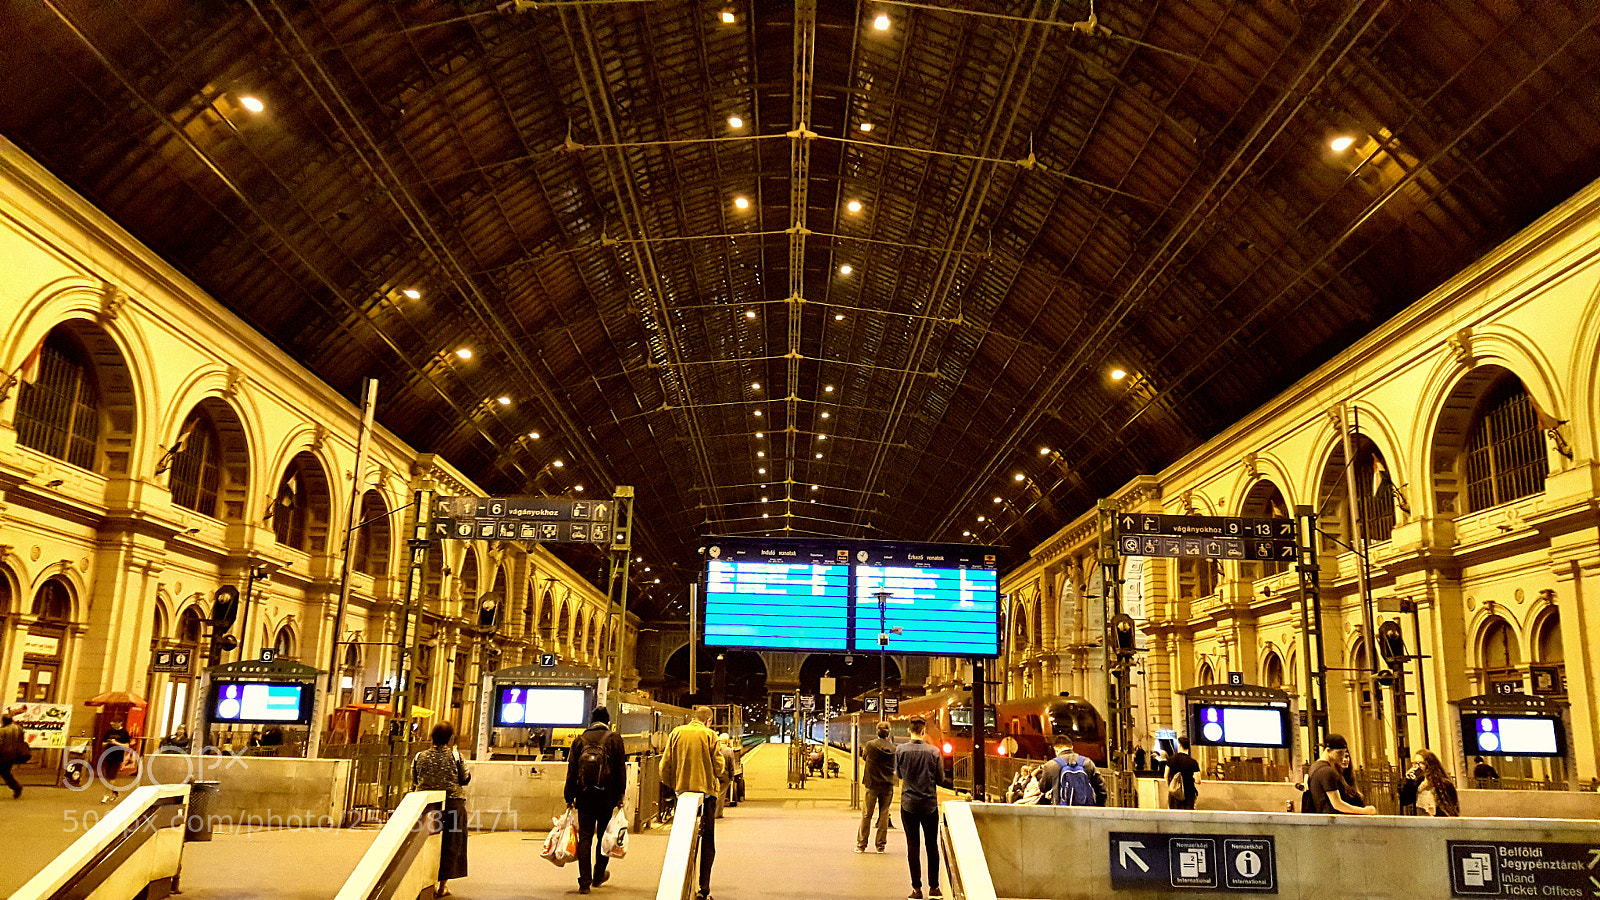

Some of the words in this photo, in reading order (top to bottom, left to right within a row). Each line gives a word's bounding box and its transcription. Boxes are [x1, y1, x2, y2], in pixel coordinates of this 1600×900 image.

[492, 503, 502, 515] 6
[1173, 525, 1222, 534] vágányokhoz
[1229, 523, 1239, 534] 9
[1255, 524, 1271, 535] 13
[262, 651, 271, 660] 6
[543, 655, 552, 664] 7
[1232, 675, 1240, 684] 8
[1503, 684, 1511, 694] 9
[510, 688, 521, 702] 7
[1499, 847, 1543, 857] Belföldi
[1500, 860, 1585, 871] Jegypénztárak
[1501, 873, 1535, 883] Inland
[1503, 885, 1538, 895] Ticket
[1542, 886, 1583, 897] Offices
